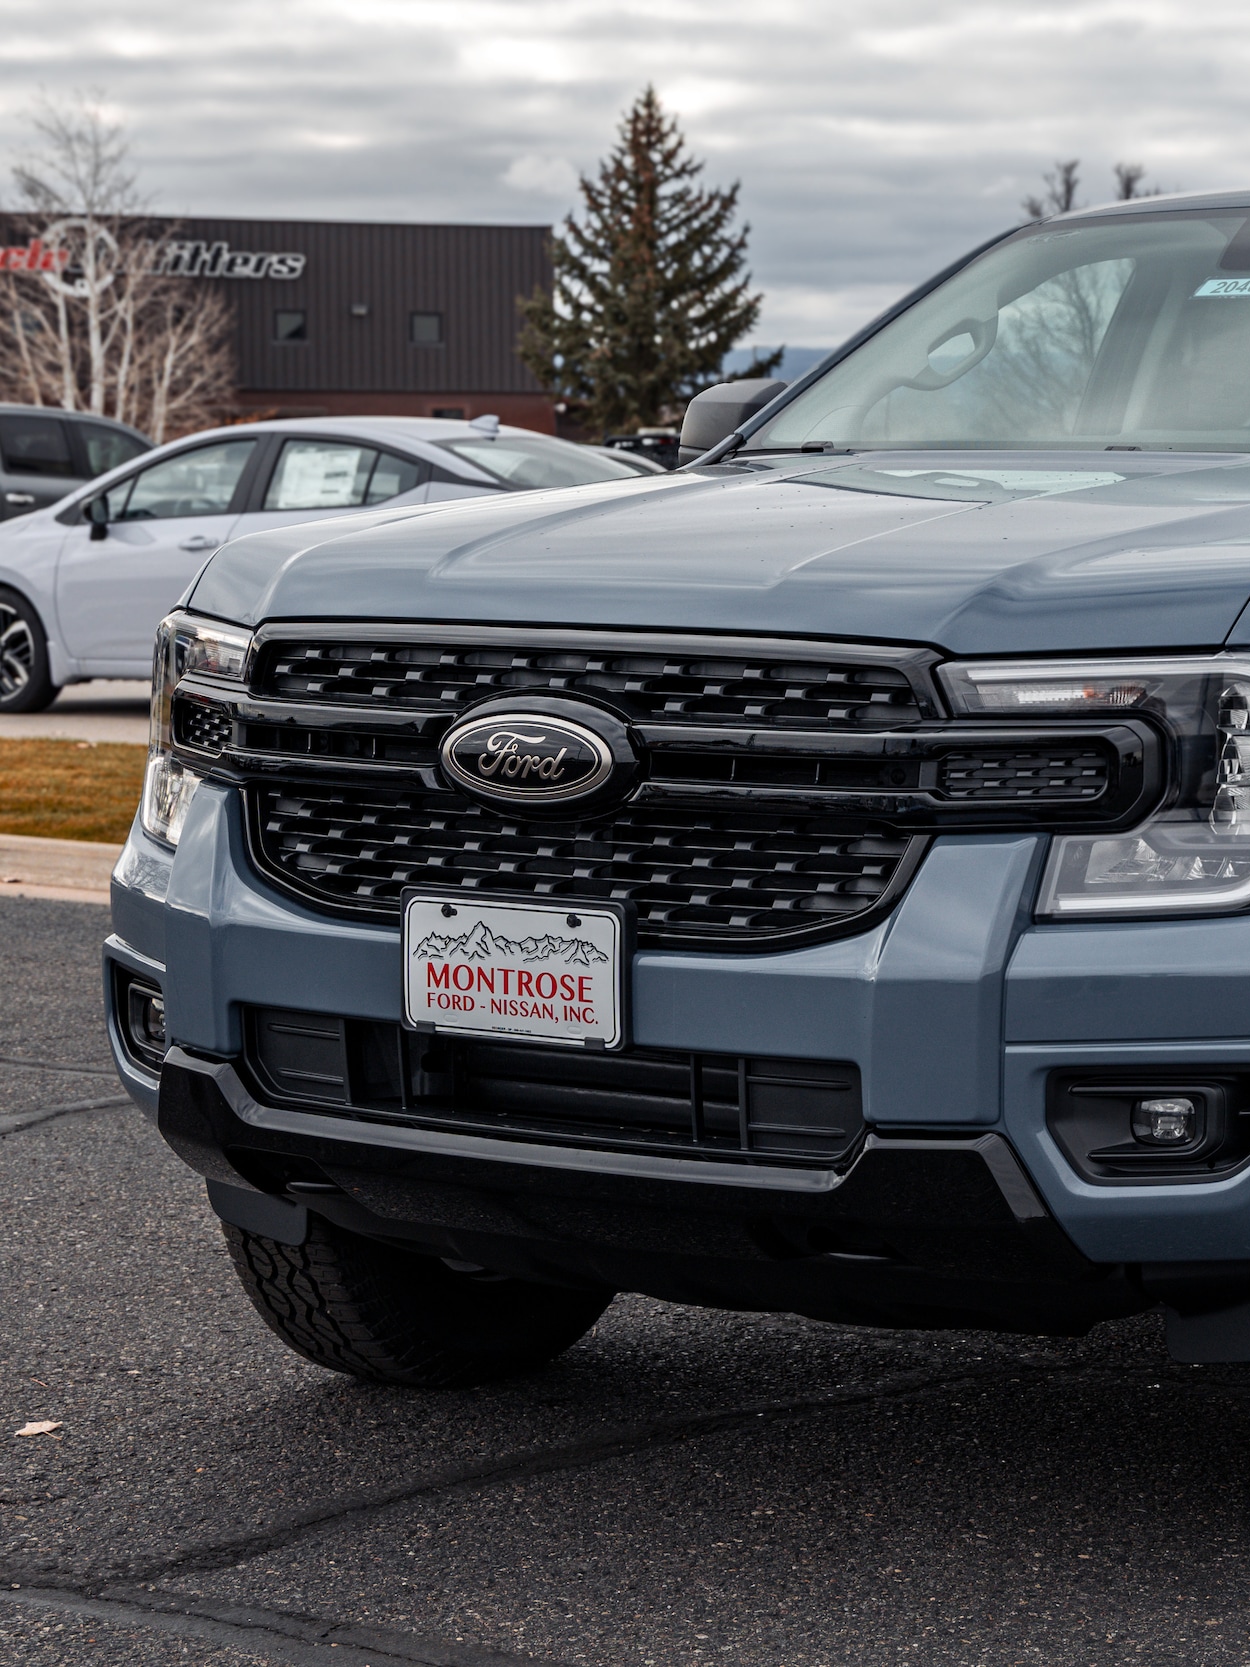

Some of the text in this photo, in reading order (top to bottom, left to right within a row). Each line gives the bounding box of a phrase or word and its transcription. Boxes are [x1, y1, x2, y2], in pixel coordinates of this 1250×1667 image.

[478, 731, 567, 781] Ford
[426, 962, 594, 1003] MONTROSE
[426, 992, 475, 1012] FORD
[490, 999, 559, 1023] NISSAN,
[563, 1005, 599, 1025] INC.
